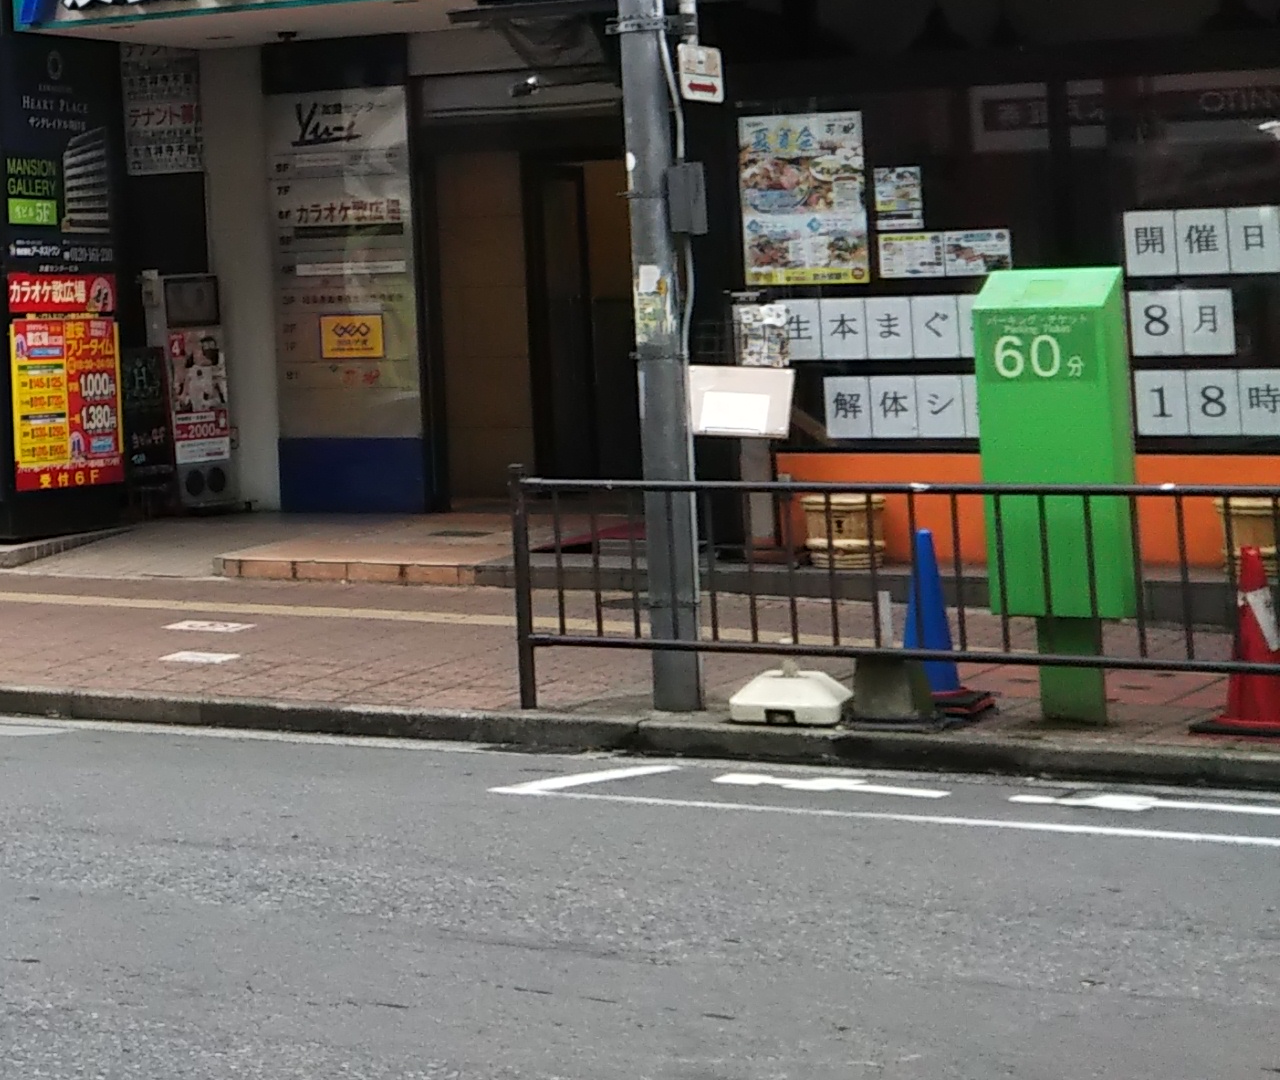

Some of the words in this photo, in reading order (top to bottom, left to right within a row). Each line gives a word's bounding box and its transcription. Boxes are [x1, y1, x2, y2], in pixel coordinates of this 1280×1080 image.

[7, 157, 56, 176] MANSION
[7, 177, 56, 197] GALLERY
[1134, 224, 1265, 255] 開催日
[10, 279, 86, 304] カラオケ歌広場
[785, 311, 974, 341] 生本まぐ
[1144, 304, 1218, 337] 8月
[66, 338, 115, 357] フリータイム
[995, 334, 1085, 379] 60分
